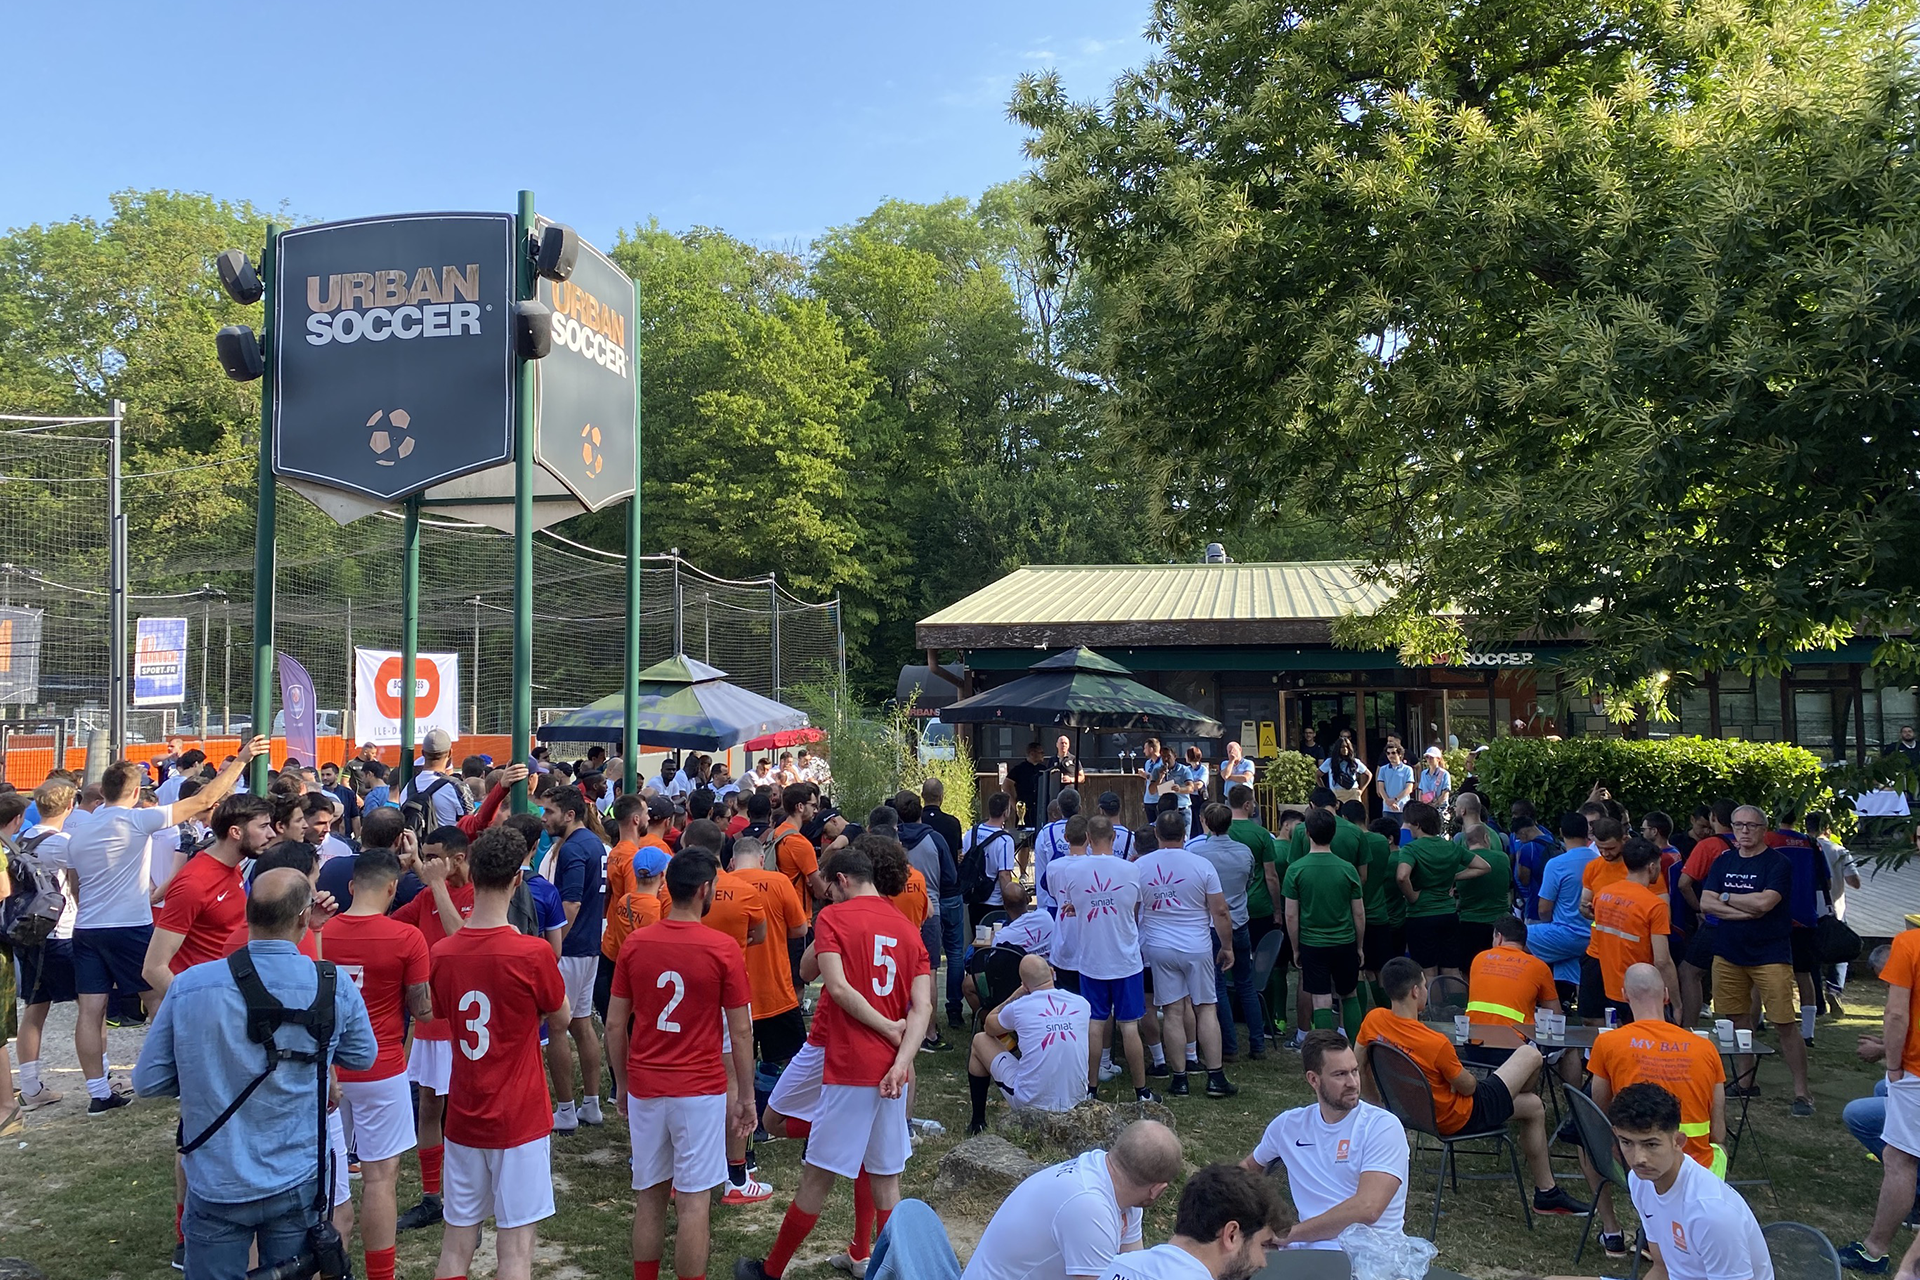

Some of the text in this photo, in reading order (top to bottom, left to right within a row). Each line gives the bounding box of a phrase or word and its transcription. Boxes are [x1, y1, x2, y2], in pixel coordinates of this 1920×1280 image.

[307, 264, 480, 313] URBAN
[306, 303, 482, 345] SOCCER
[551, 280, 625, 349] URBAN
[551, 311, 627, 378] SOCCER
[141, 665, 176, 675] SPORT.FR
[1090, 898, 1115, 907] siniat
[872, 935, 897, 996] 5
[458, 990, 491, 1061] 3
[656, 970, 685, 1033] 2
[1046, 1022, 1074, 1032] siniat
[1629, 1037, 1655, 1049] MV
